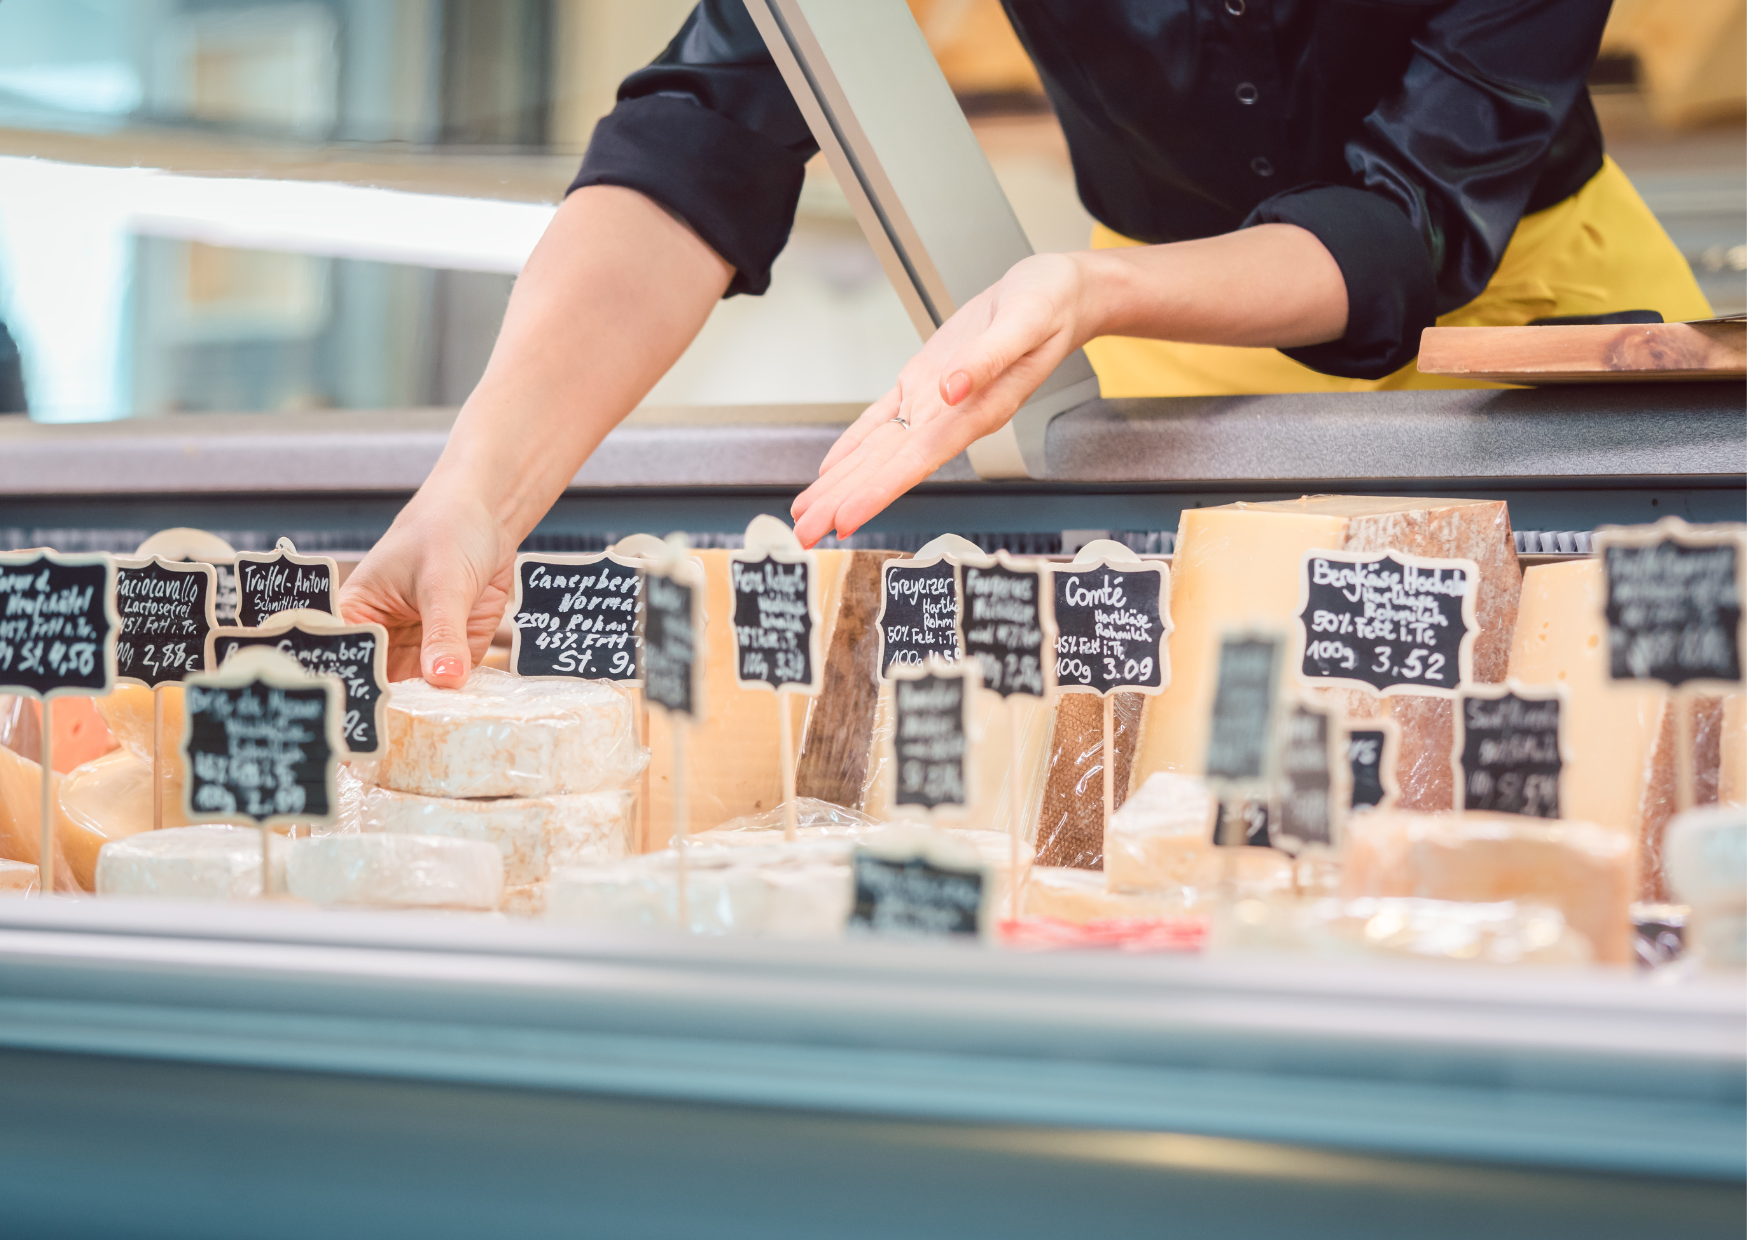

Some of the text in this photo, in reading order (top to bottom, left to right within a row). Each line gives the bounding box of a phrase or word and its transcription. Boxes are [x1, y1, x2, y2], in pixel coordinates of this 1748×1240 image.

[887, 568, 953, 606] Greyerzer
[1065, 574, 1127, 608] Comté
[1313, 558, 1401, 603] Bergkäse
[124, 599, 191, 619] Lactosefrei
[1095, 608, 1152, 629] Hartkäse
[143, 616, 170, 635] Fett
[517, 612, 560, 632] 250g
[1095, 622, 1152, 643] Rohmilch
[1311, 609, 1354, 635] 50%
[1354, 616, 1397, 641] Fett
[535, 631, 578, 650] 45%
[911, 628, 936, 644] Fett
[1079, 637, 1101, 655] Fett
[552, 649, 597, 674] St.
[1052, 656, 1092, 684] 100g
[1306, 640, 1446, 681] 100g 3,52
[348, 678, 370, 700] Tr.
